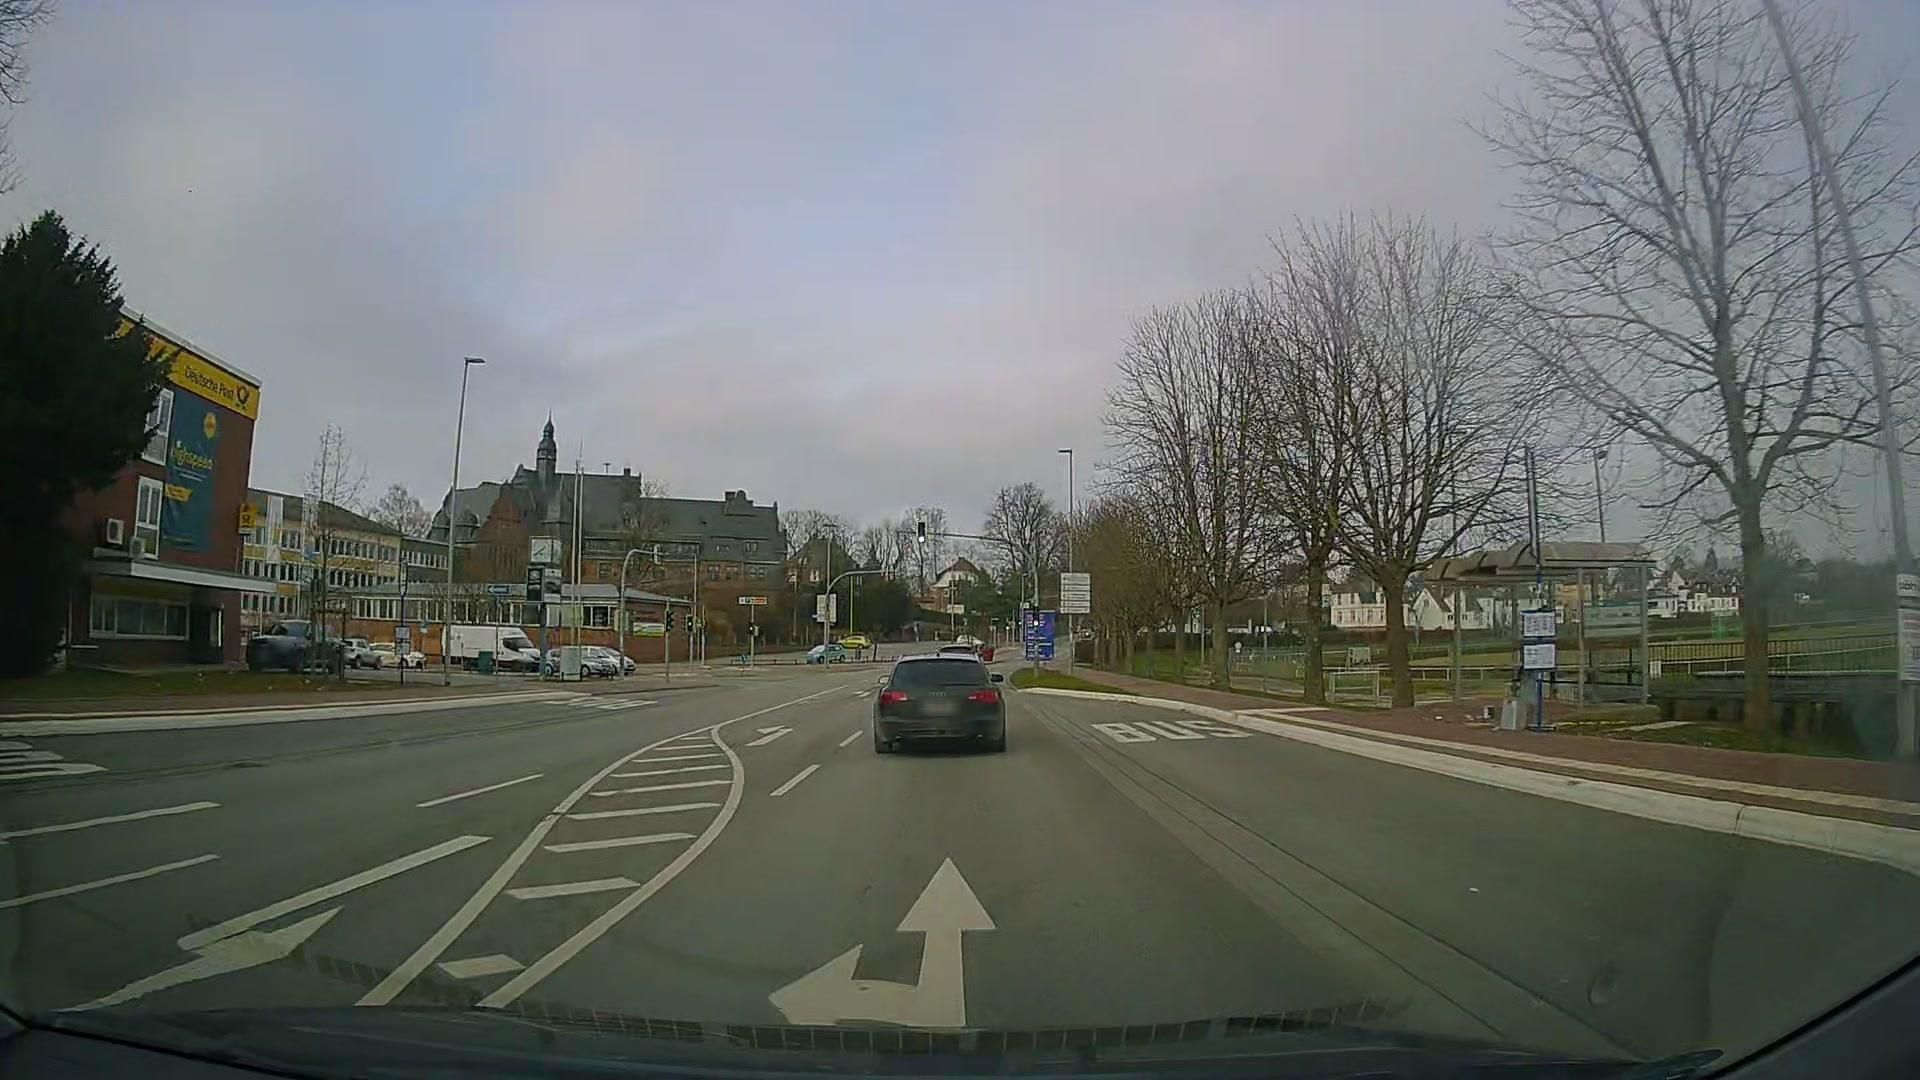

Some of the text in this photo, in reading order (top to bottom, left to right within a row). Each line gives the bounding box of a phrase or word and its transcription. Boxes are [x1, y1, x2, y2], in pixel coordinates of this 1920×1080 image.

[184, 366, 234, 400] Deutsche Post
[1090, 720, 1255, 743] BUS
